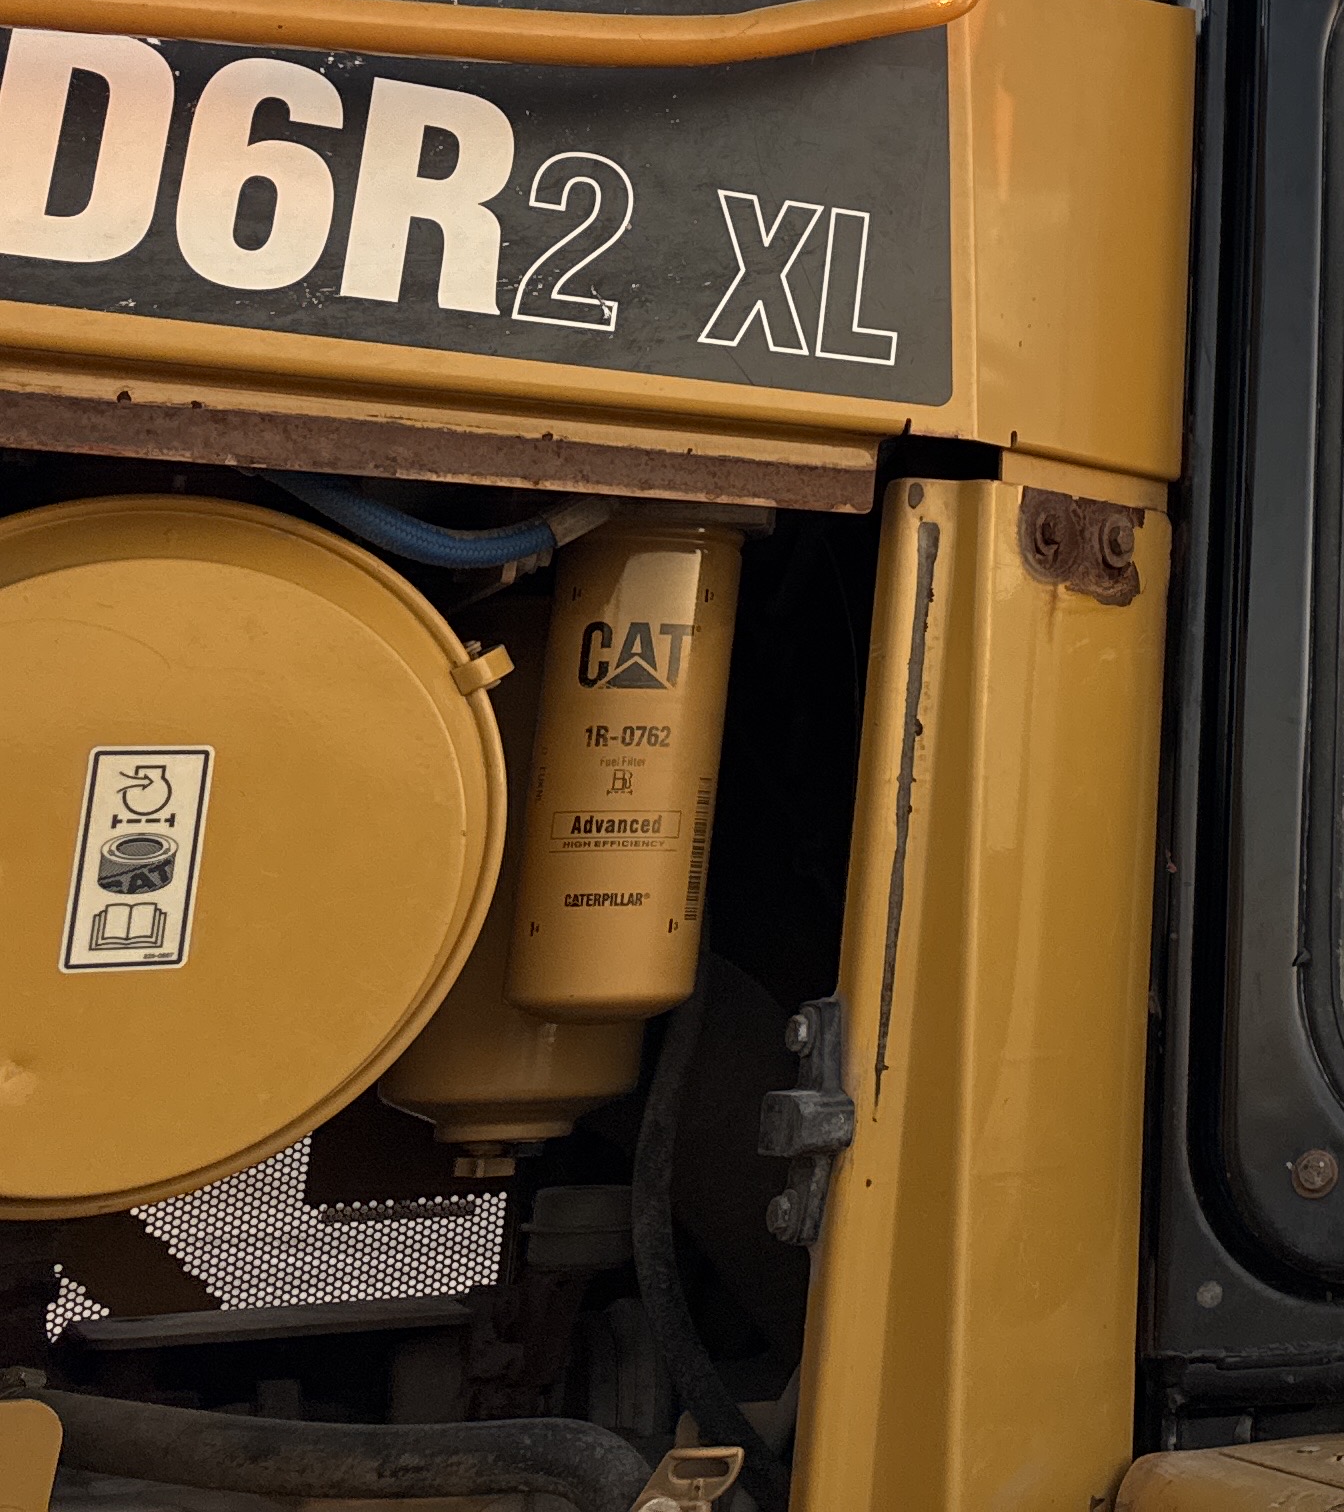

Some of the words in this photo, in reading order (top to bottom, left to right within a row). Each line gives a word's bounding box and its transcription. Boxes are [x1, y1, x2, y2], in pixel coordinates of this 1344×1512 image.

[697, 188, 898, 366] XL
[578, 621, 694, 689] CAT
[585, 724, 672, 748] 1R-0762
[621, 755, 646, 768] Filter
[570, 814, 663, 835] Advanced
[562, 839, 592, 849] HIGH
[593, 839, 666, 849] EFFICIENCY
[564, 892, 643, 908] CATERPILLAR
